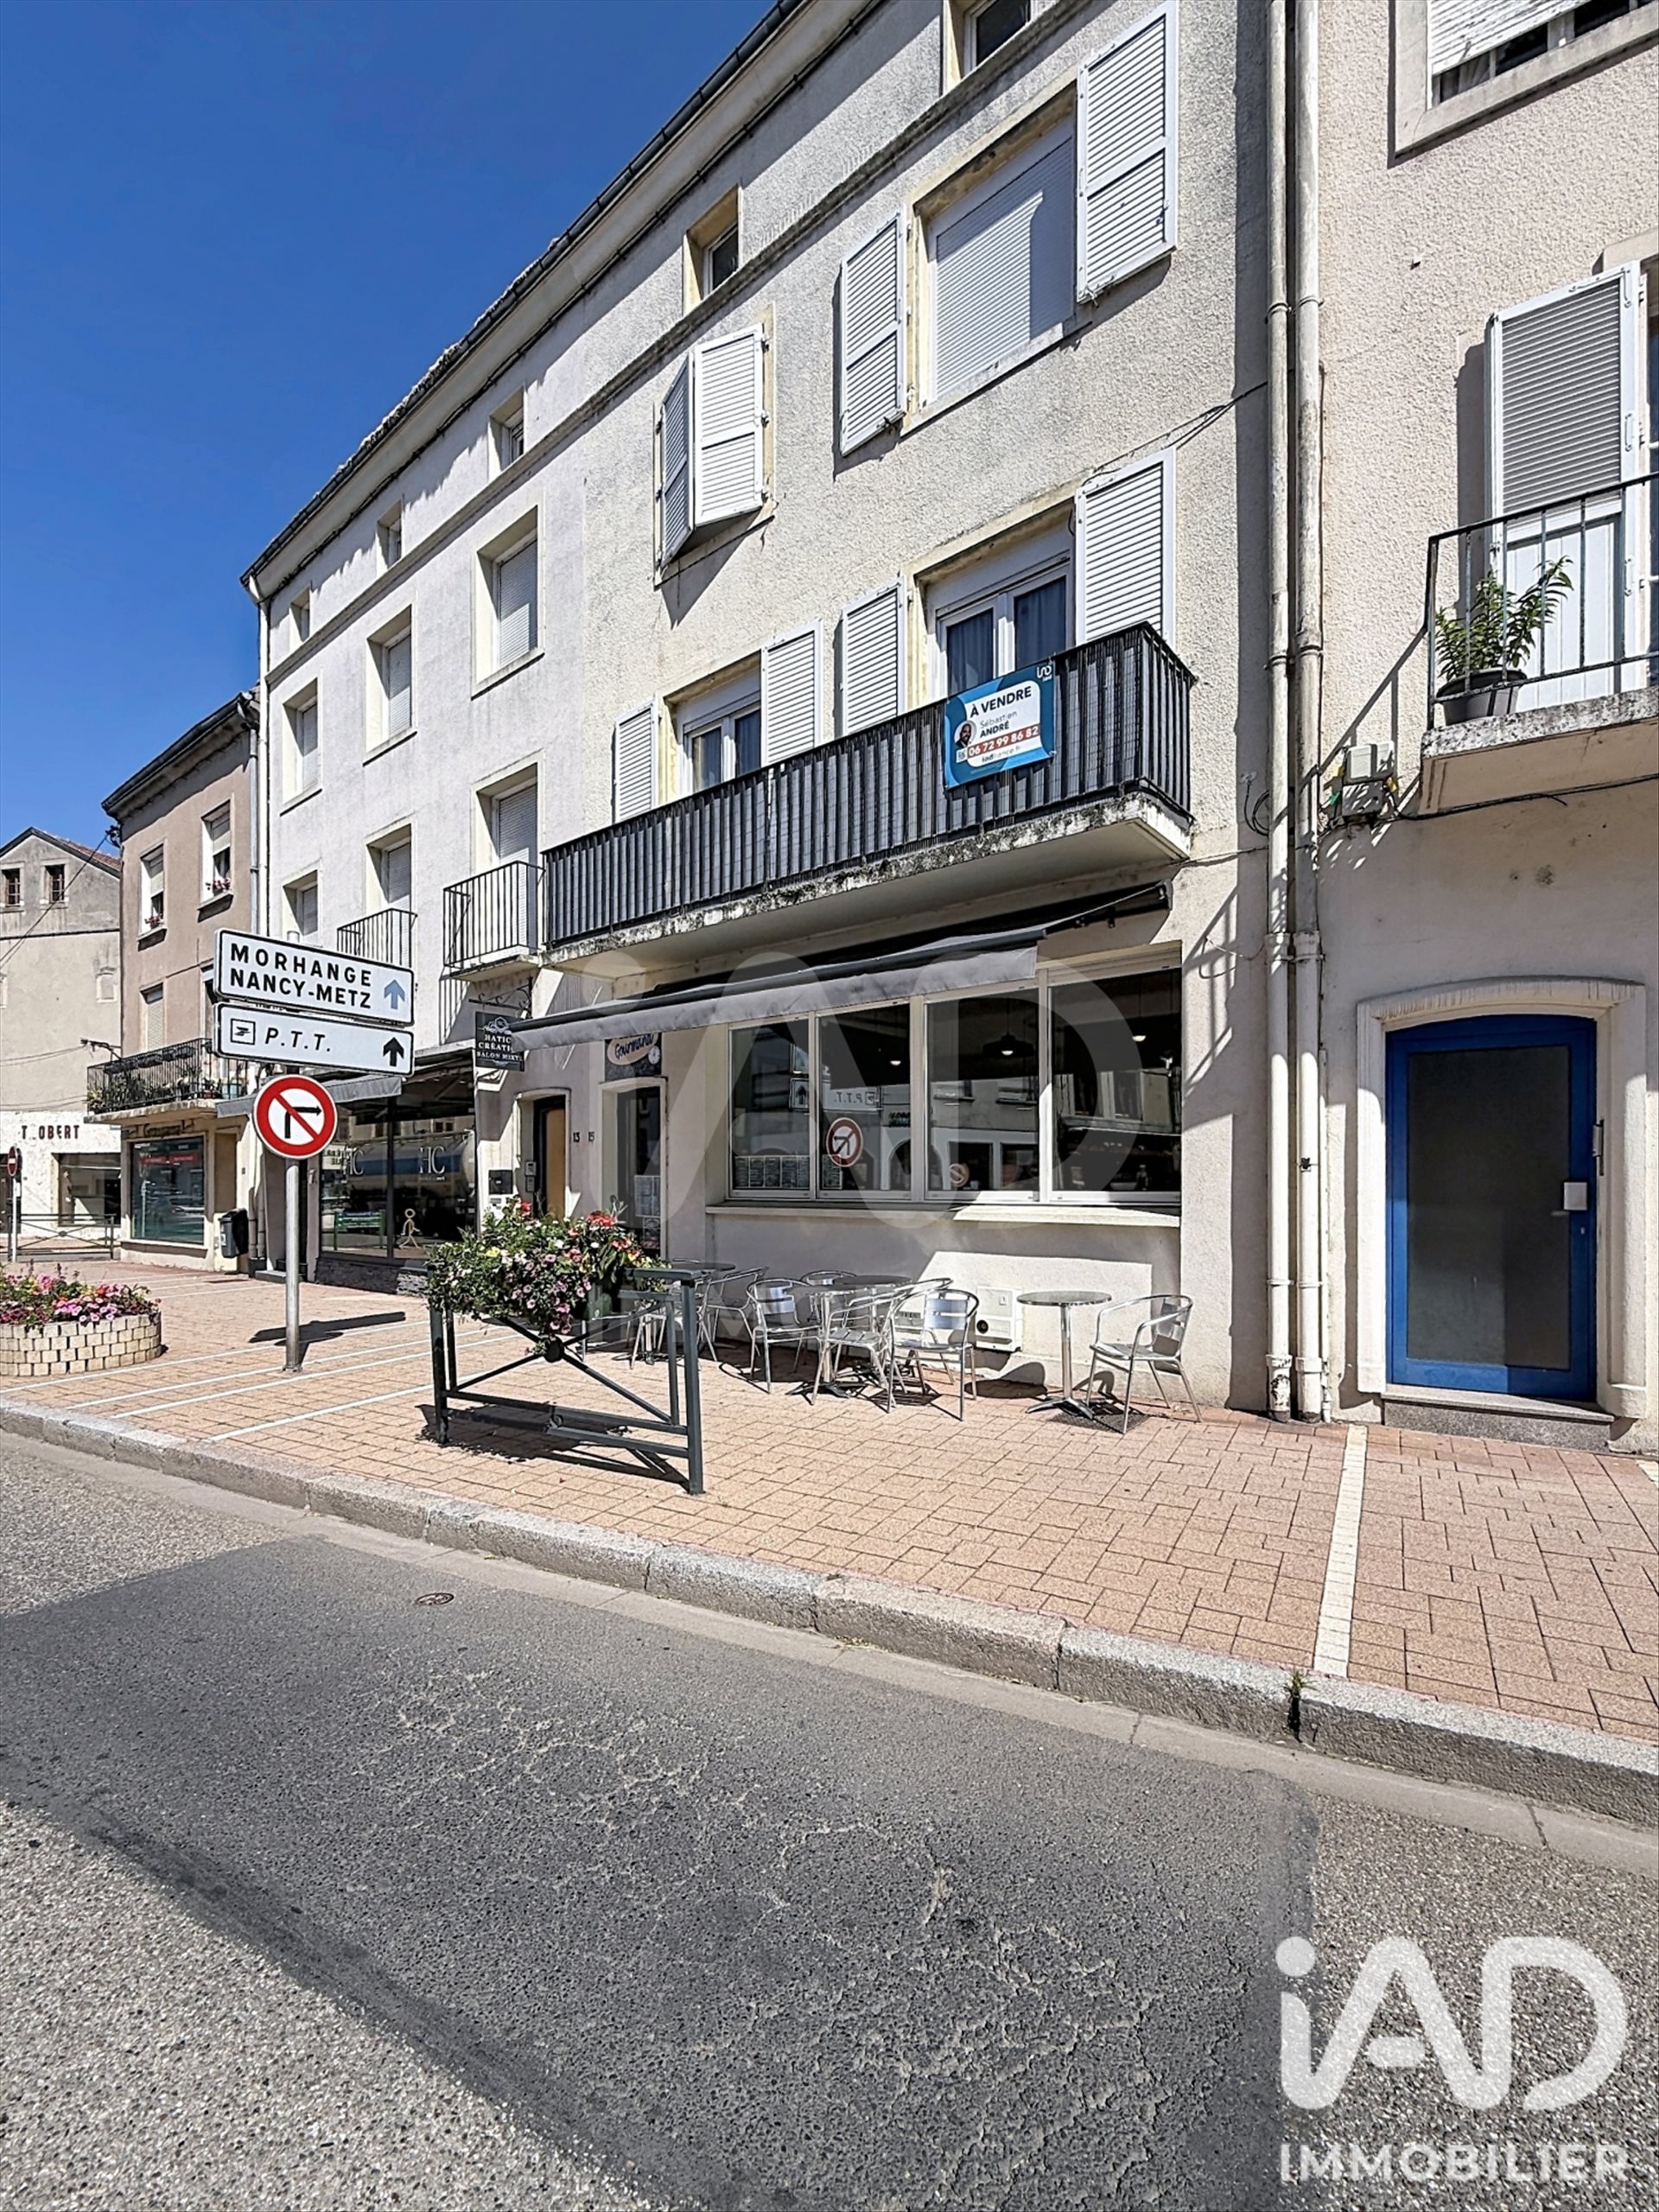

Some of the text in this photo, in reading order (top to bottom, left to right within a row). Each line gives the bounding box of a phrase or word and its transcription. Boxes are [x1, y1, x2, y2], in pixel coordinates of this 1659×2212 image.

[970, 686, 1032, 718] À VENDRE
[980, 710, 1018, 728] Sébastien
[980, 721, 1009, 738] ANDRÉ
[969, 726, 1039, 757] 06 72 99 86 82
[231, 943, 372, 987] MORHANGE
[231, 968, 372, 1009] NANCY-METZ
[264, 1027, 331, 1052] P.T.T.
[478, 1041, 511, 1052] CRÉATI
[484, 1033, 512, 1044] HATIC
[573, 1130, 595, 1143] 13 15
[419, 1145, 446, 1175] HC
